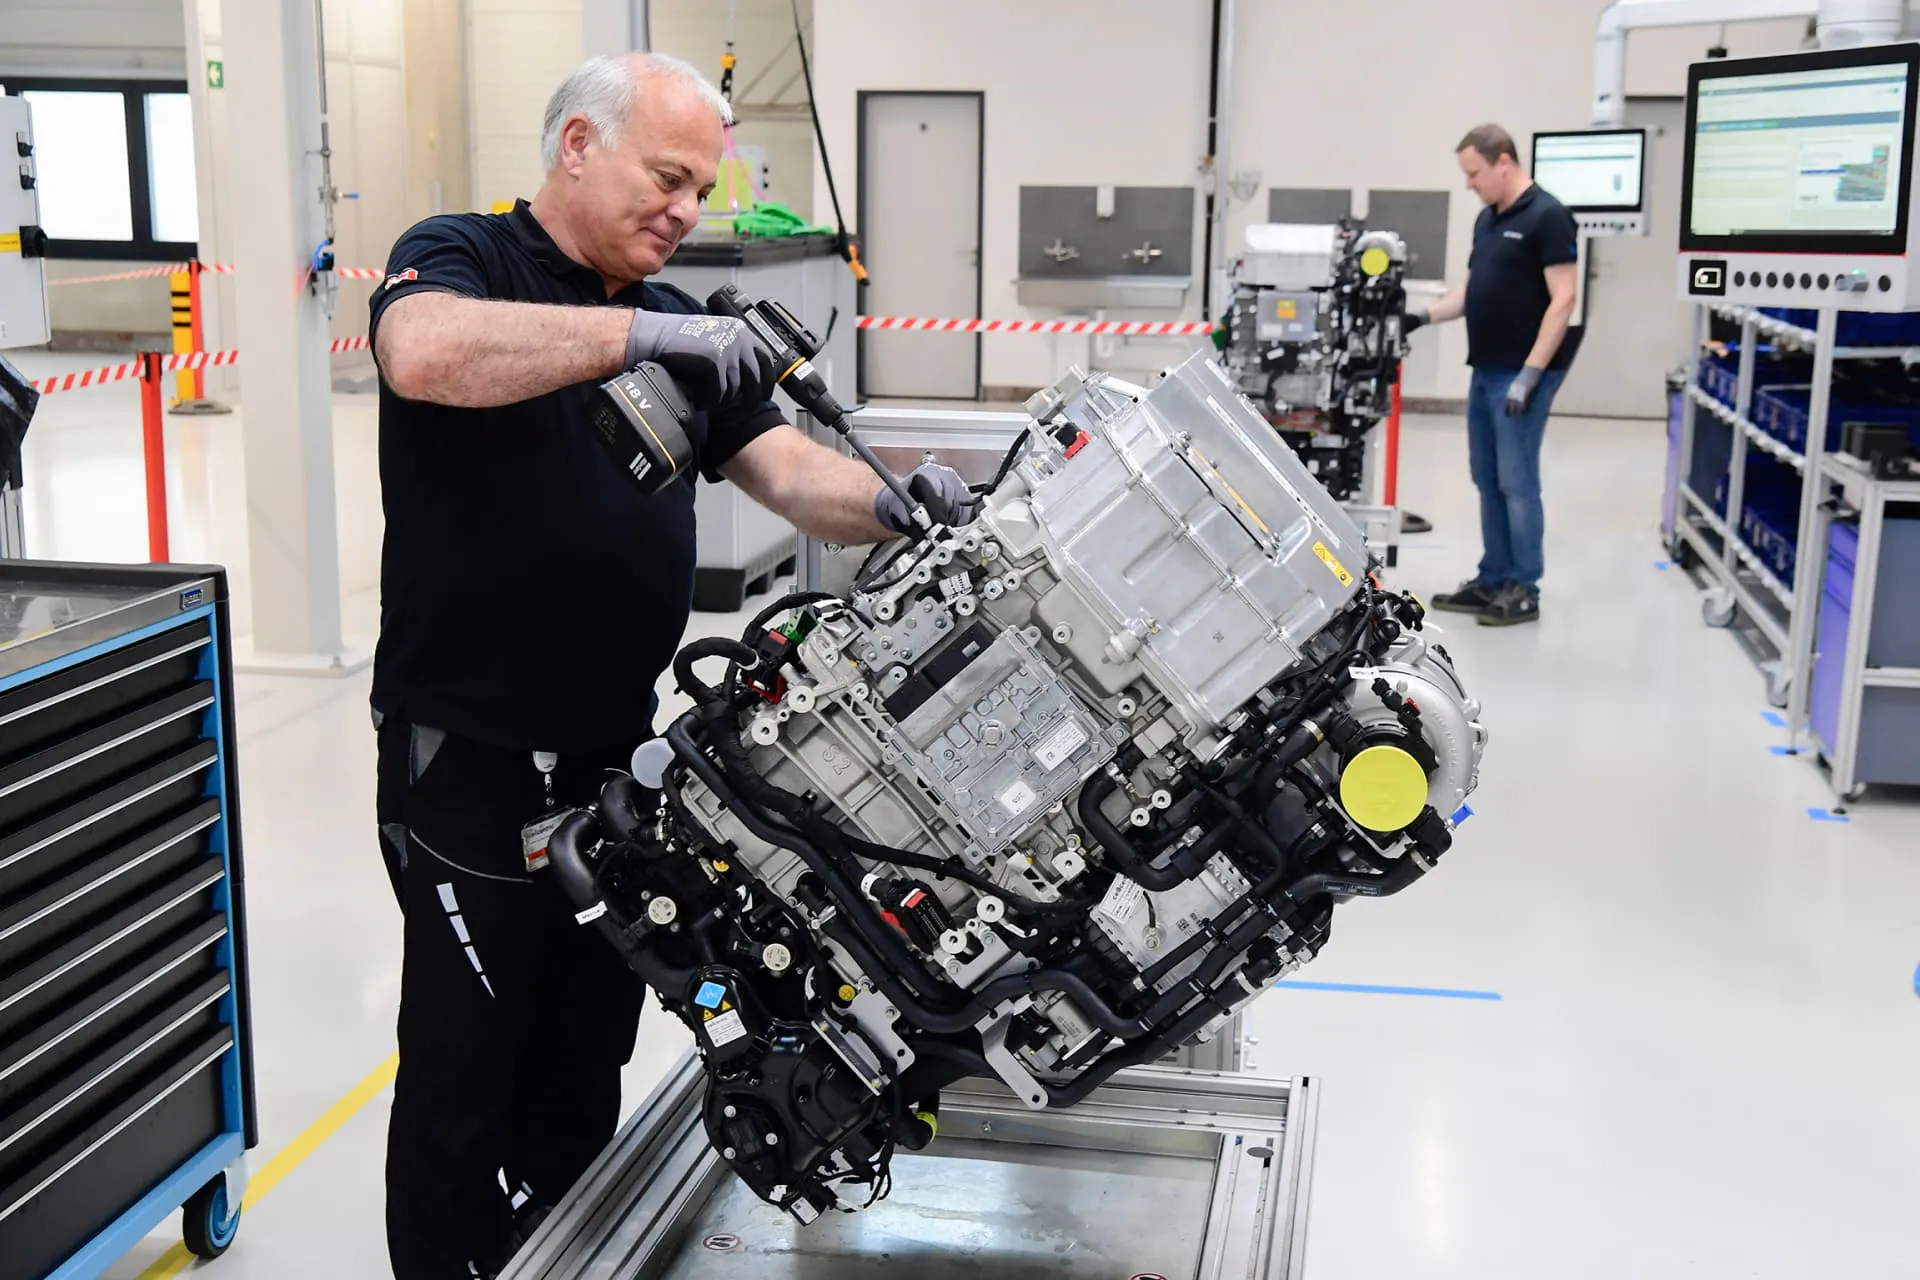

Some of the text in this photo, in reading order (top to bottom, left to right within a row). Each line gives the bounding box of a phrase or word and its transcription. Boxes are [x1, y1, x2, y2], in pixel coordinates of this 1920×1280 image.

[624, 381, 653, 411] 18 V
[822, 743, 851, 776] S2
